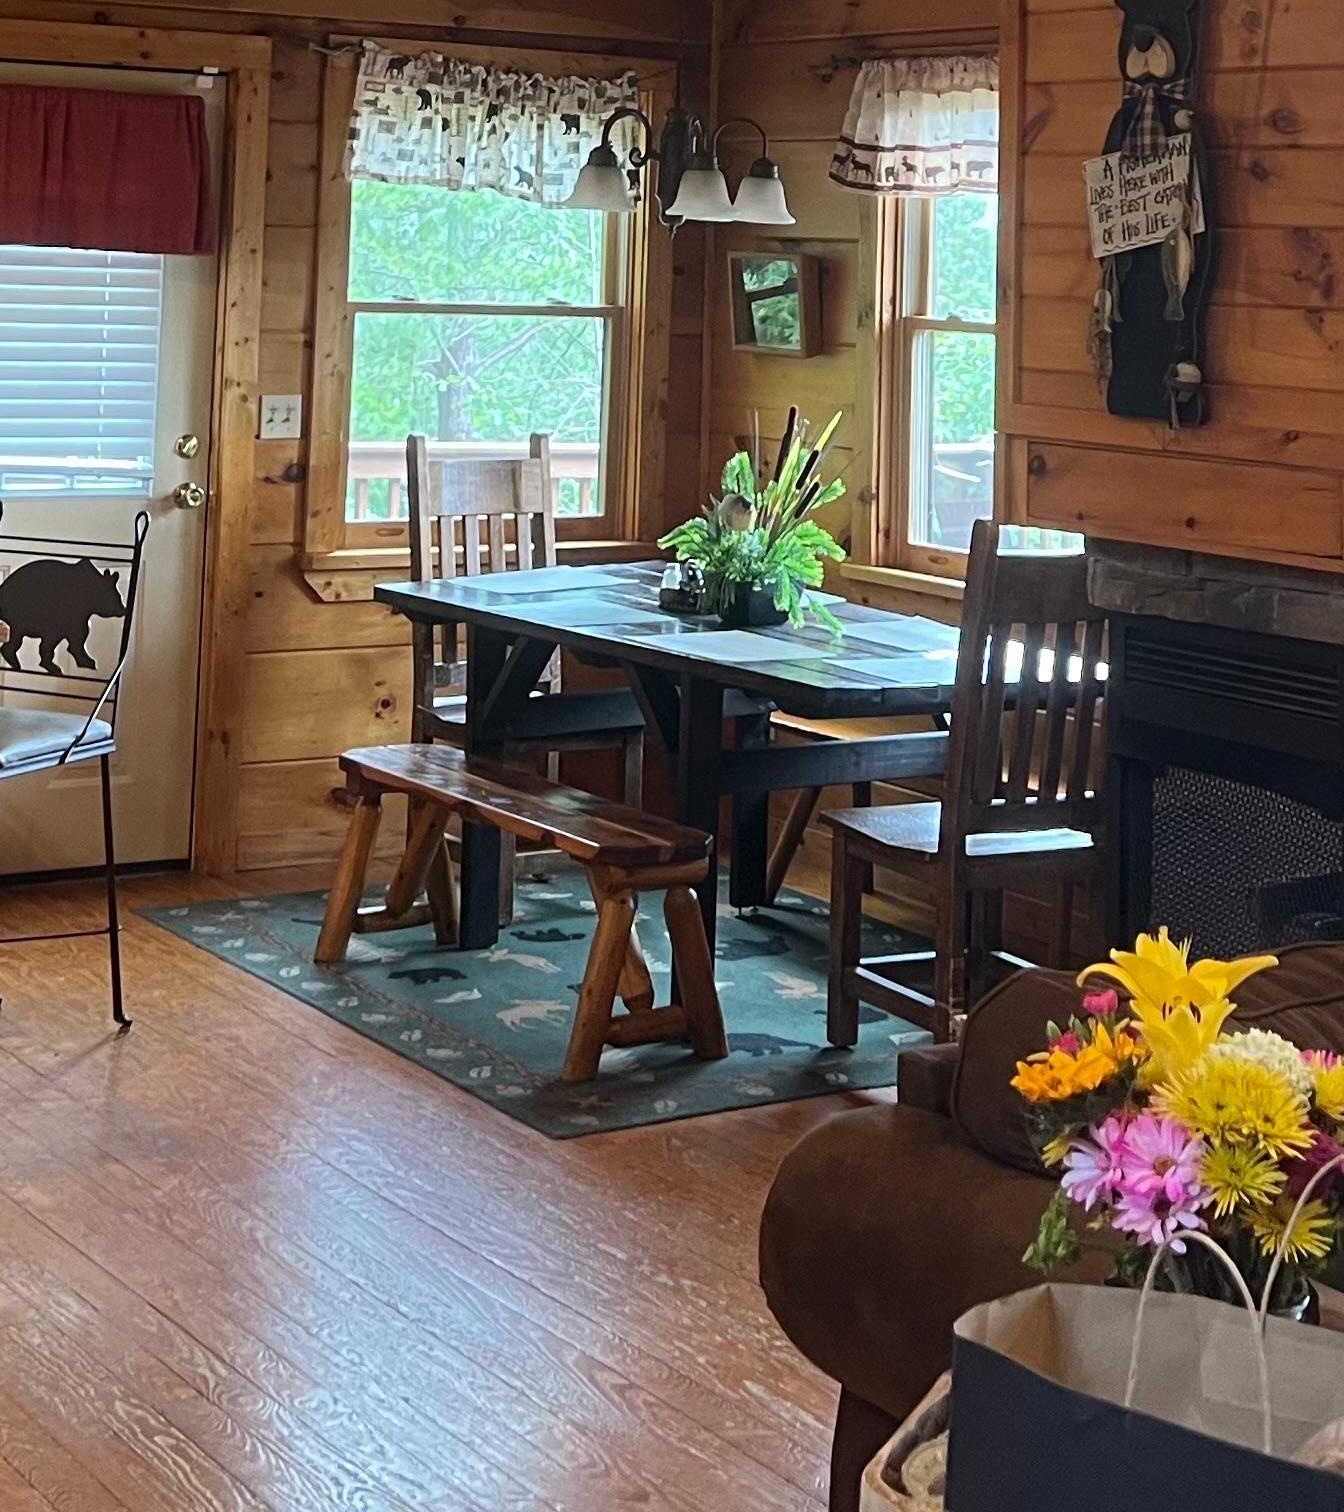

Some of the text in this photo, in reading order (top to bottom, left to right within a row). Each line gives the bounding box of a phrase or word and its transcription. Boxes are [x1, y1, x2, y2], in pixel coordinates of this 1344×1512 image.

[1103, 159, 1114, 182] A
[1119, 174, 1147, 198] HERE
[1149, 162, 1174, 186] WITH
[1119, 192, 1151, 216] BEST
